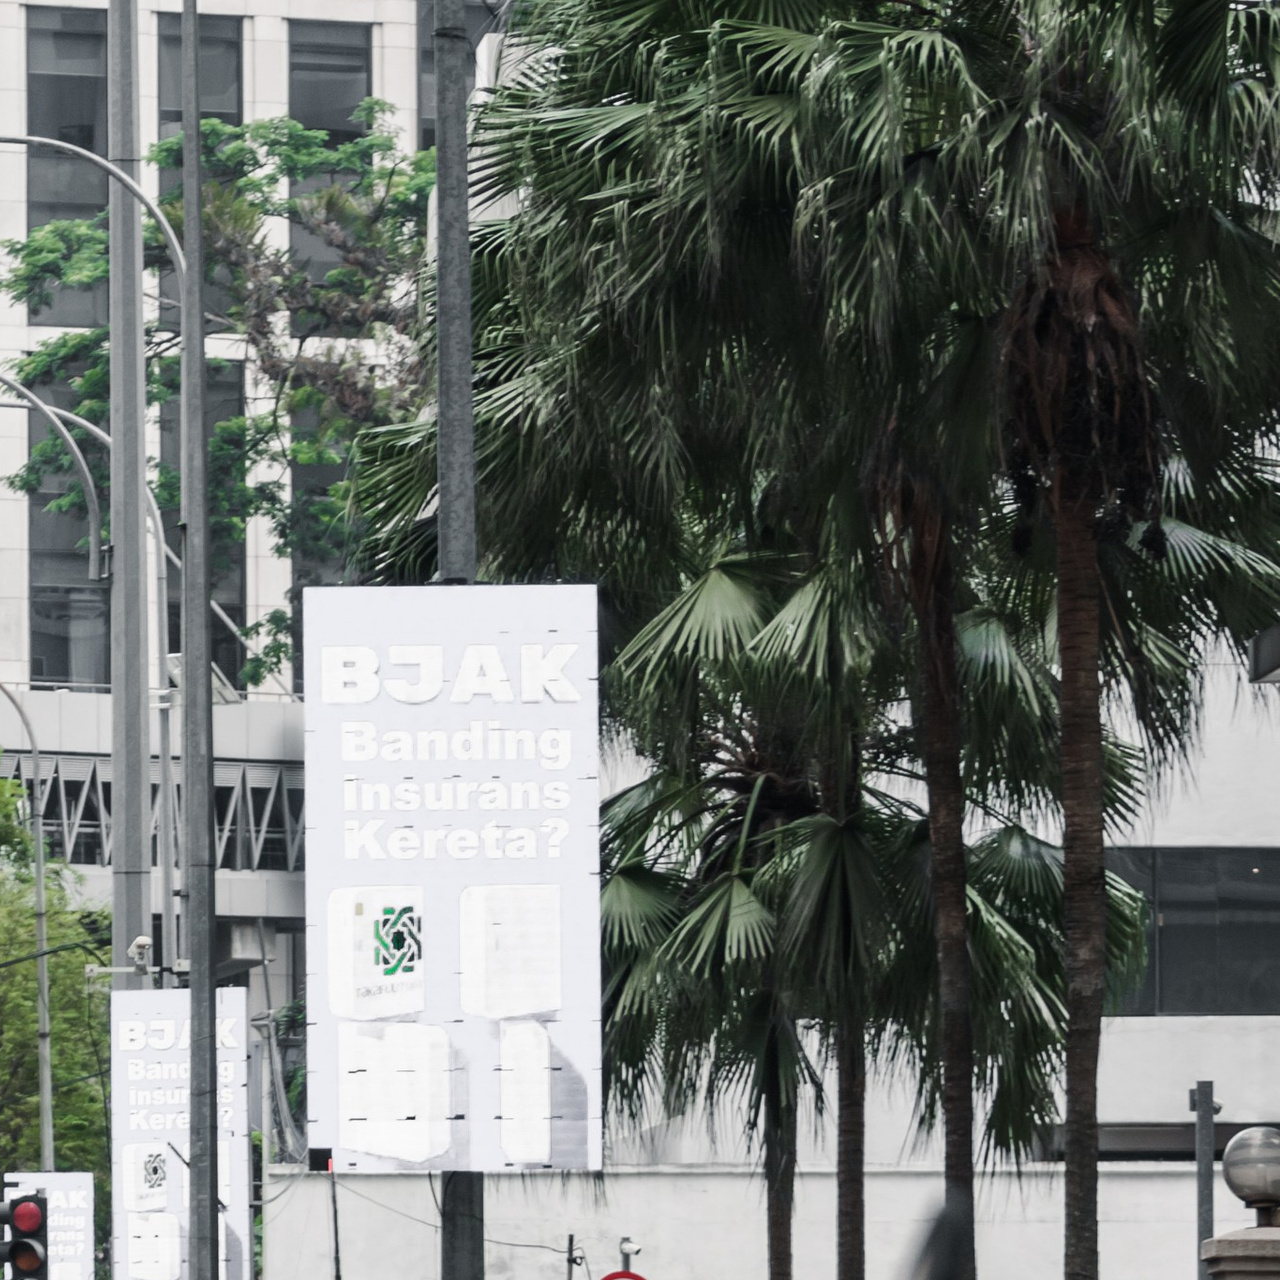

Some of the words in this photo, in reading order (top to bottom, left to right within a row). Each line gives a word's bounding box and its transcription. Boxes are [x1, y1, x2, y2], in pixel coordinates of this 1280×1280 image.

[321, 644, 581, 705] BJAK
[341, 720, 572, 770] Banding
[343, 818, 569, 860] Kereta?
